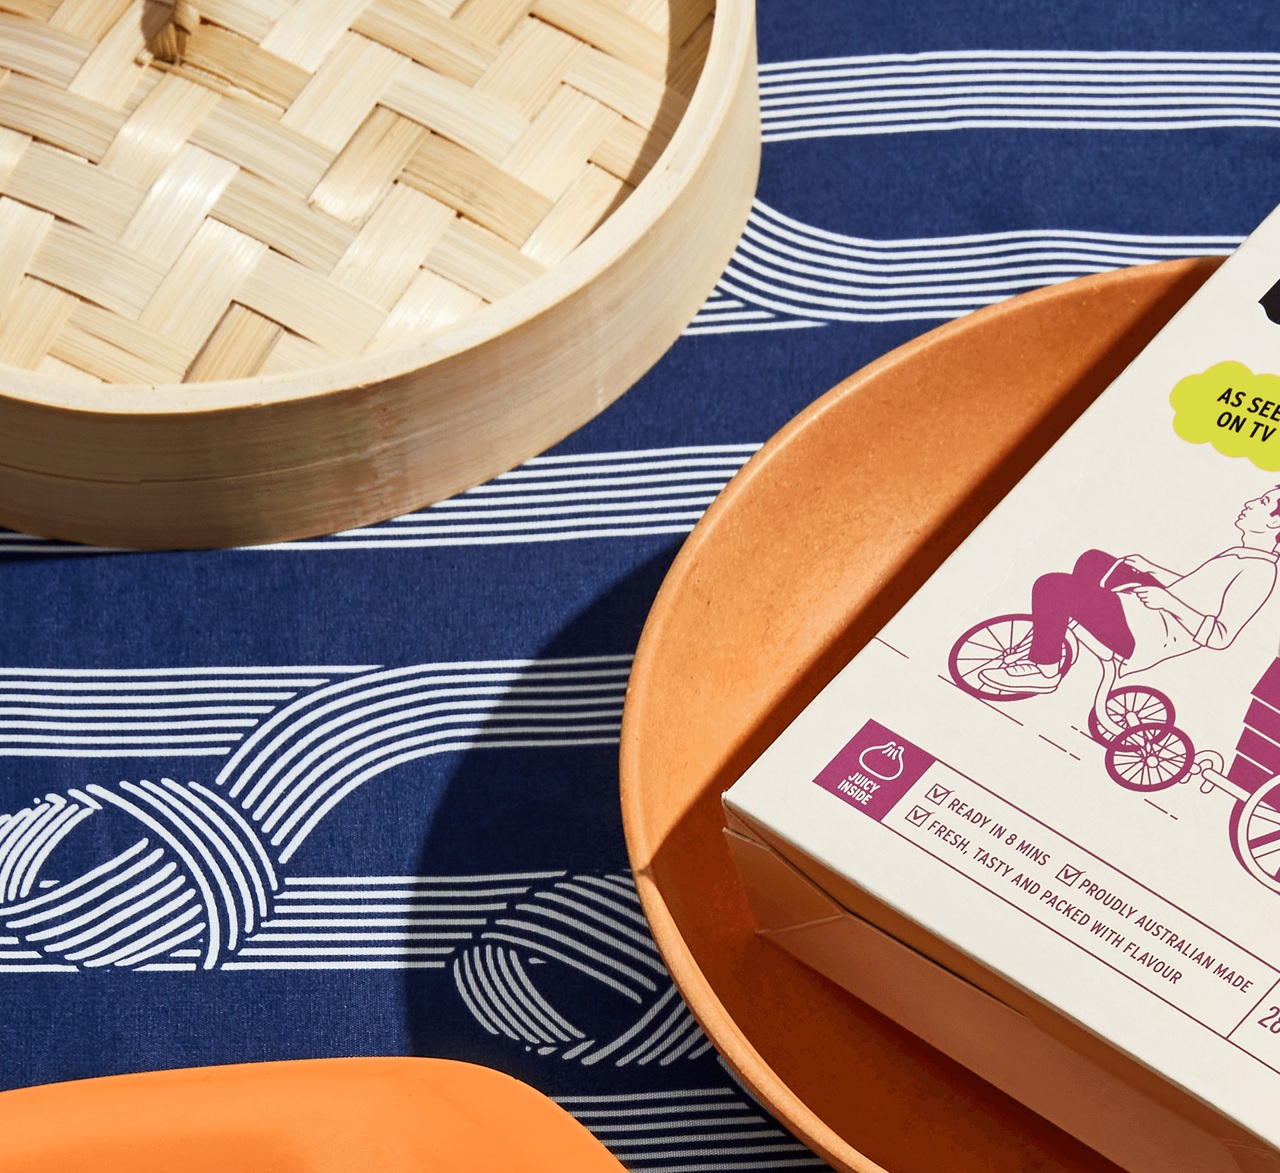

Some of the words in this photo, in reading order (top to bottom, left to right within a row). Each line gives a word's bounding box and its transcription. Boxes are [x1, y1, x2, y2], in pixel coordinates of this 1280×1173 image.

[1216, 387, 1247, 408] AS
[1216, 403, 1247, 433] ON
[1249, 421, 1277, 443] TV
[837, 779, 873, 806] INSIDE
[848, 772, 881, 798] JUICY
[947, 797, 992, 828] READY
[988, 823, 1008, 839] IN
[1004, 833, 1018, 846] 8
[1015, 839, 1051, 866] MINS
[926, 819, 971, 855] FRESH,
[973, 847, 1014, 877] TASTY
[1010, 873, 1041, 895] AND
[1039, 889, 1091, 926] PACKED
[1089, 920, 1126, 948] WITH
[1122, 941, 1183, 985] FLAVOUR
[1077, 878, 1138, 919] PROUDLY
[1134, 915, 1216, 970] AUSTRALIAN
[1212, 963, 1254, 994] MADE
